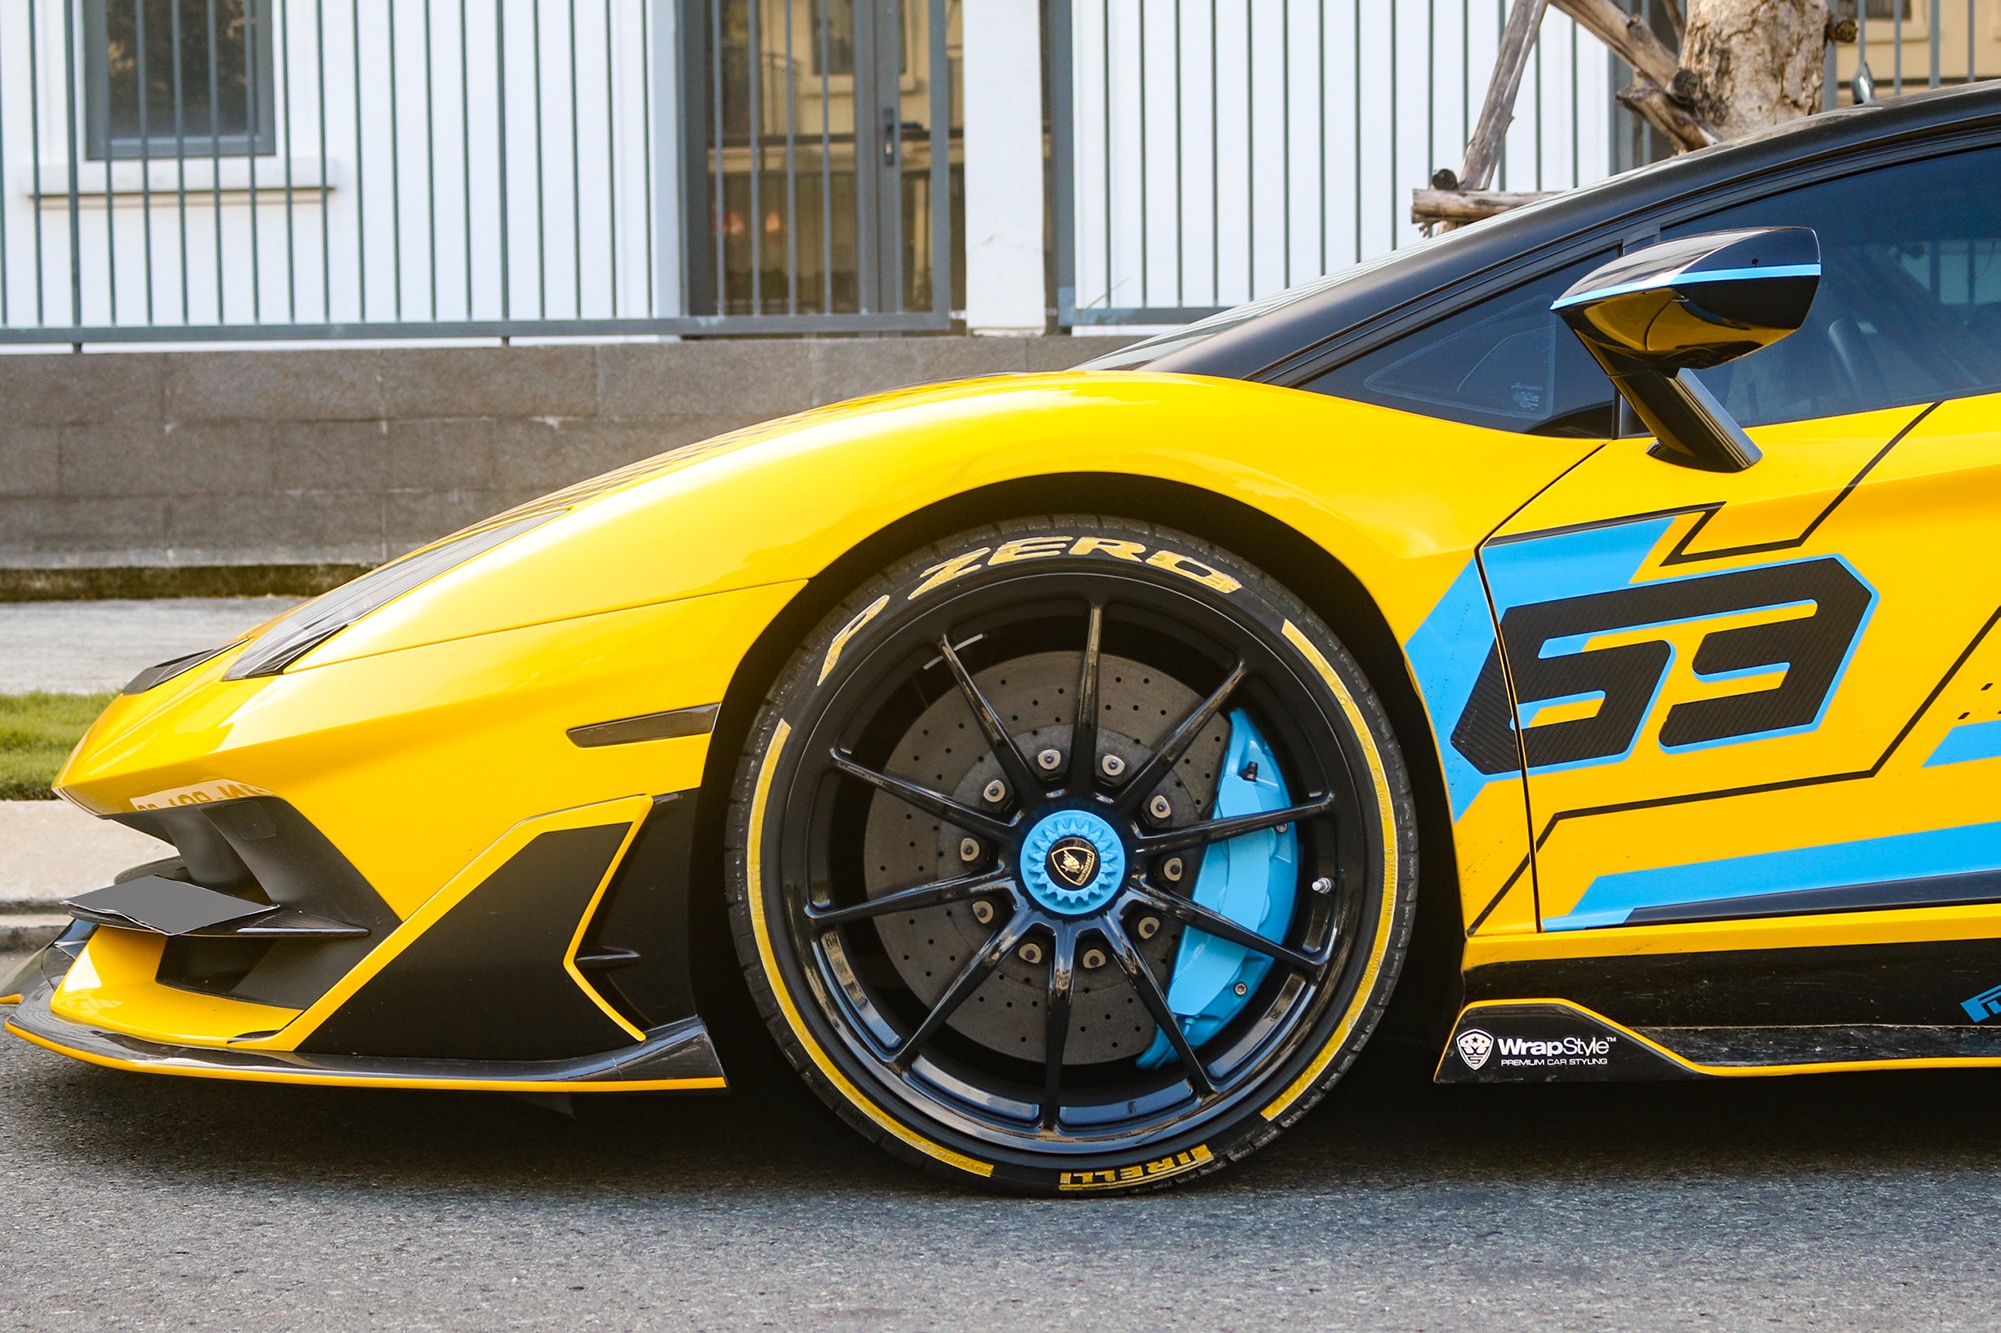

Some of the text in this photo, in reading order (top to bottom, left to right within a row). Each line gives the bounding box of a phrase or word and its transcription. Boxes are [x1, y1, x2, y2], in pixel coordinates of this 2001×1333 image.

[817, 535, 1243, 686] P ZERO
[1450, 556, 1874, 776] 63
[1547, 1058, 1567, 1066] CAR
[1569, 1058, 1608, 1066] STYLING
[1058, 1143, 1214, 1191] PIRELLI
